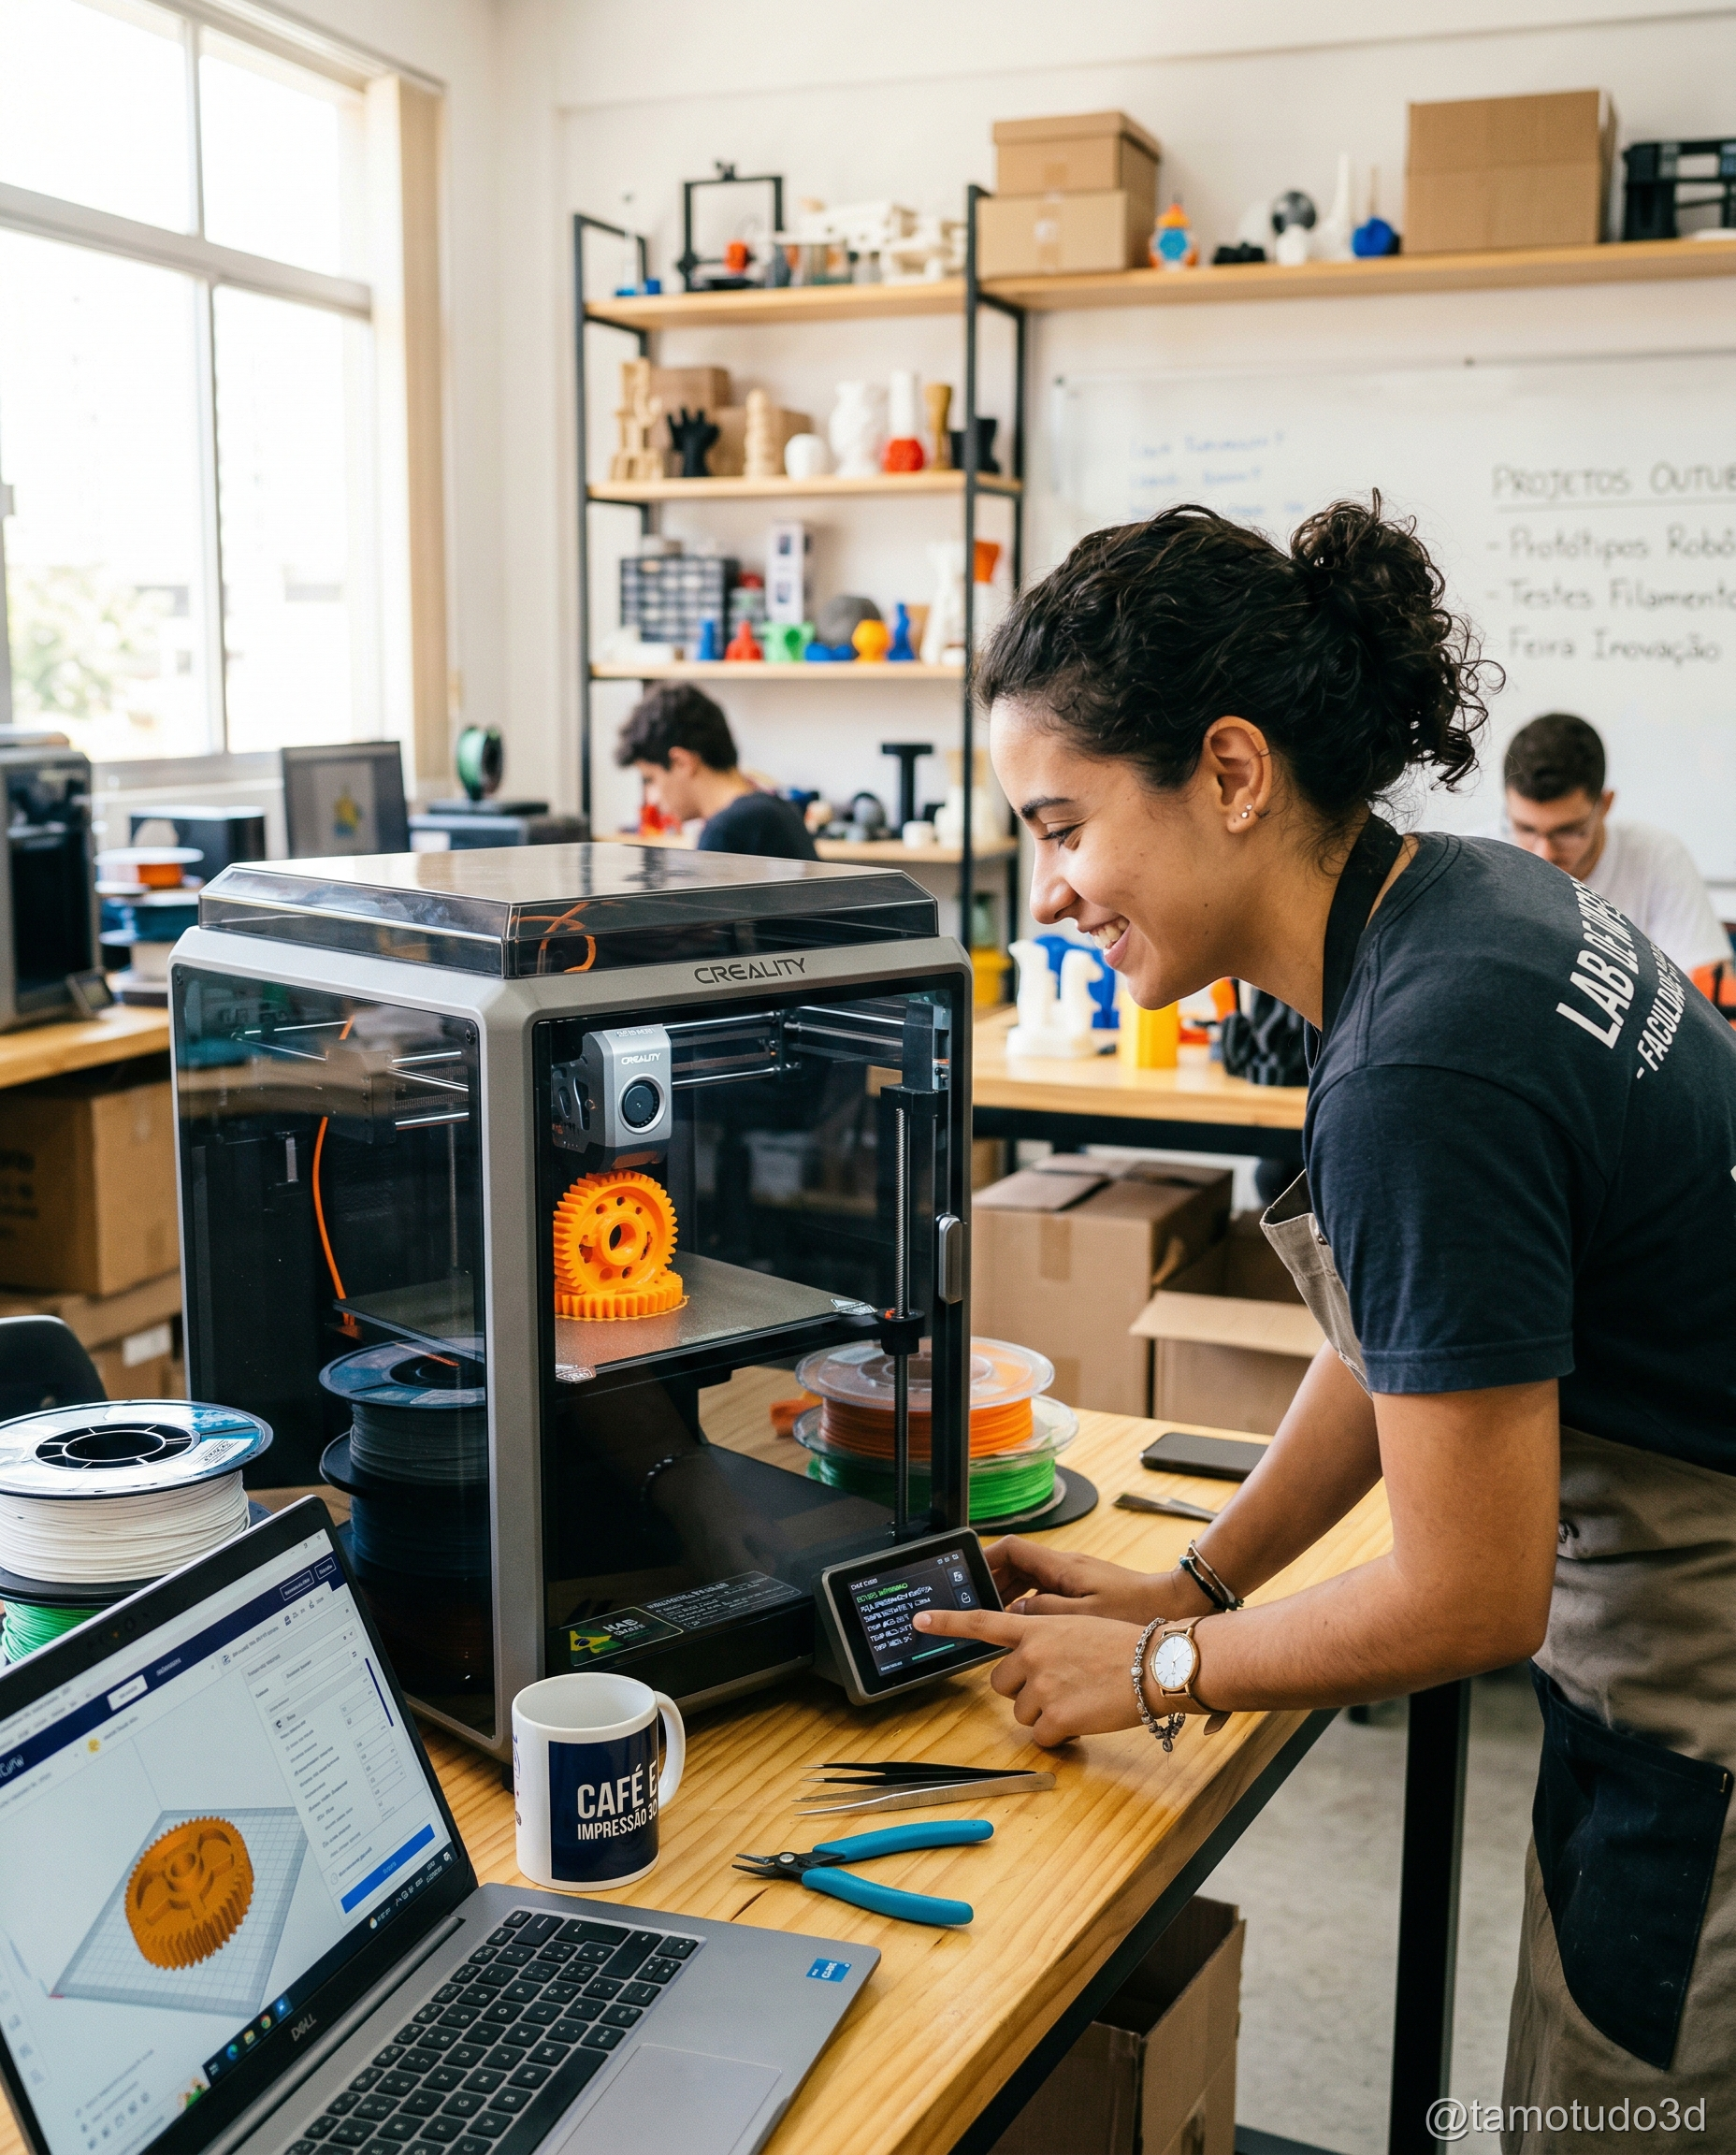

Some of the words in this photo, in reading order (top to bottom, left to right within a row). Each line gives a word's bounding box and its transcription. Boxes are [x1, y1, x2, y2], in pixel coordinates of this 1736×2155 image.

[1493, 465, 1631, 499] PROJETOS
[1507, 577, 1595, 609] Testes
[1592, 627, 1721, 668] Inovação
[1582, 920, 1640, 975] DE
[694, 958, 805, 984] CREALITY
[1555, 949, 1635, 1049] LAB
[621, 1052, 661, 1065] CREALITY
[577, 1763, 644, 1819] CAFÉ
[577, 1807, 647, 1841] IMPRESSÃO
[291, 2013, 318, 2042] DELL
